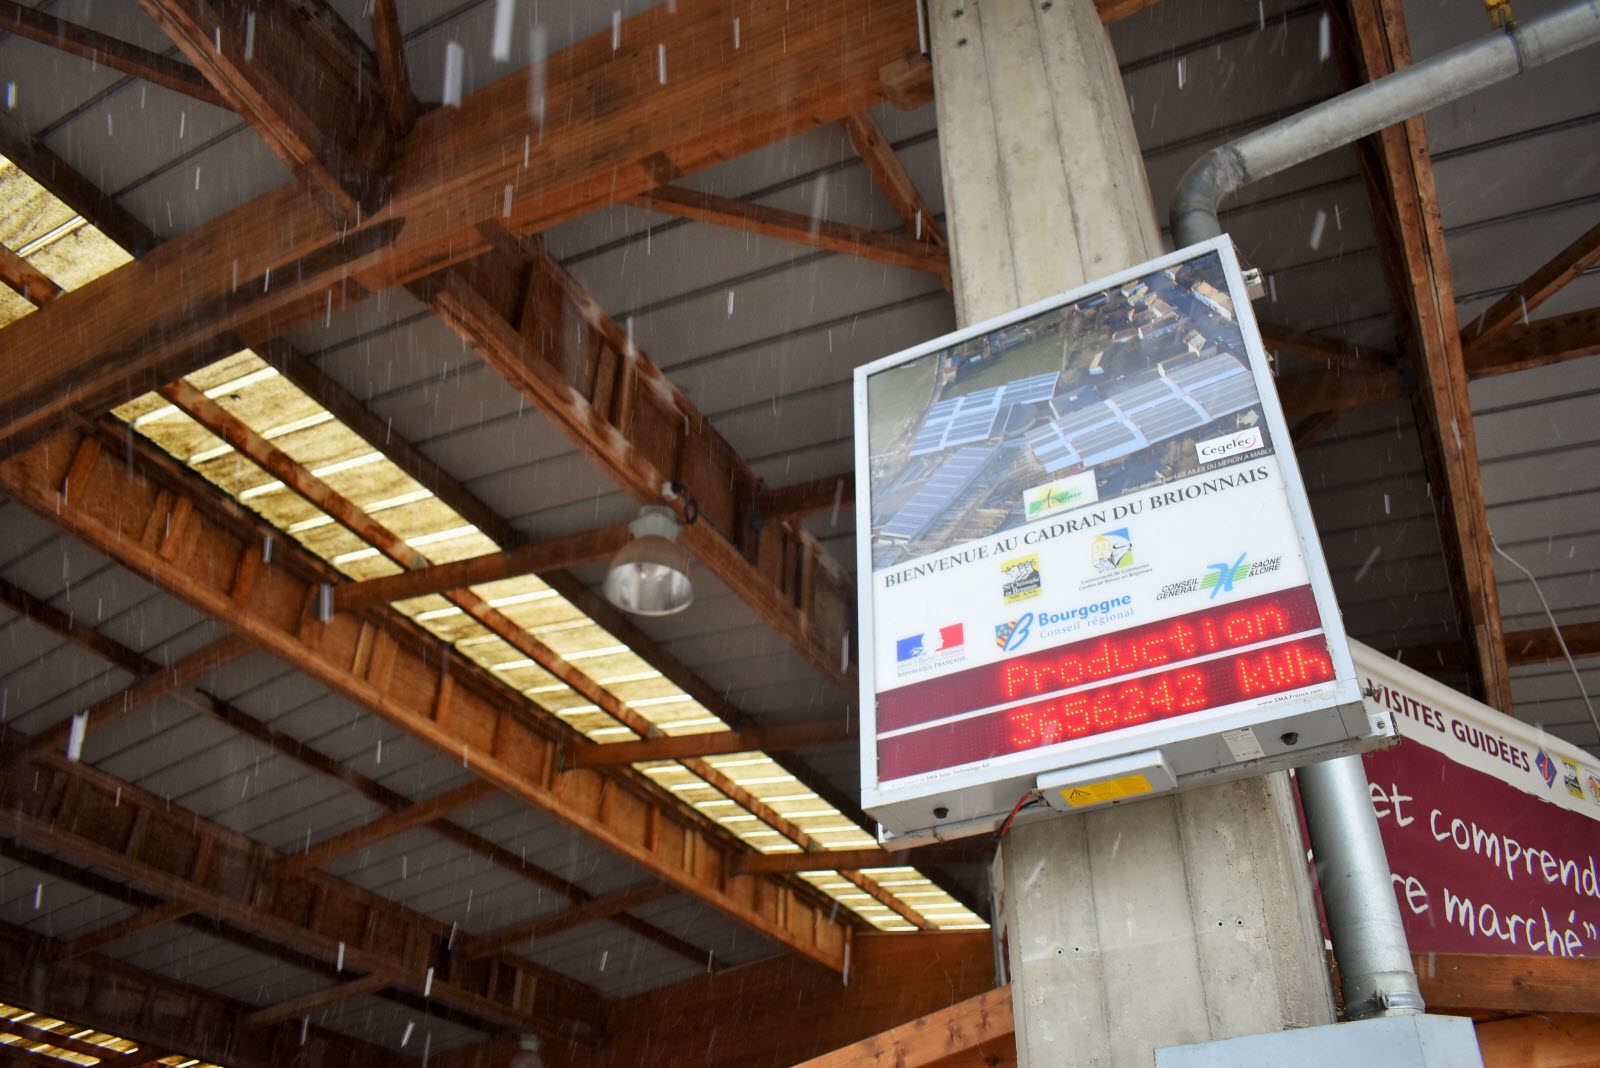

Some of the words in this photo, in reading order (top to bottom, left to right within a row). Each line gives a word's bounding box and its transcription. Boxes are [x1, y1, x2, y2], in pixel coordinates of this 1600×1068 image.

[1201, 435, 1254, 458] Cegelec
[1174, 470, 1187, 479] LES
[1187, 466, 1206, 476] AILES
[1249, 447, 1274, 458] MABLY
[884, 545, 990, 588] BIENVENUE
[993, 536, 1018, 555] AU
[1023, 511, 1107, 546] CADRAN
[1111, 499, 1144, 521] DU
[1149, 466, 1270, 512] BRIONNAIS
[1079, 583, 1097, 591] Canton
[1080, 573, 1113, 585] Communauté
[1120, 563, 1150, 574] Communes
[1161, 577, 1200, 593] CONSEIL
[1038, 595, 1132, 627] Bourgogne
[1040, 620, 1080, 639] Conseil
[1087, 607, 1135, 630] régional
[1006, 608, 1284, 697] Production
[1010, 673, 1206, 745] 3656242
[1240, 648, 1328, 692] kWh
[1367, 678, 1446, 734] VISITES
[1451, 718, 1531, 774] GUIDÉES
[952, 766, 981, 776] Technology
[1368, 782, 1415, 827] et
